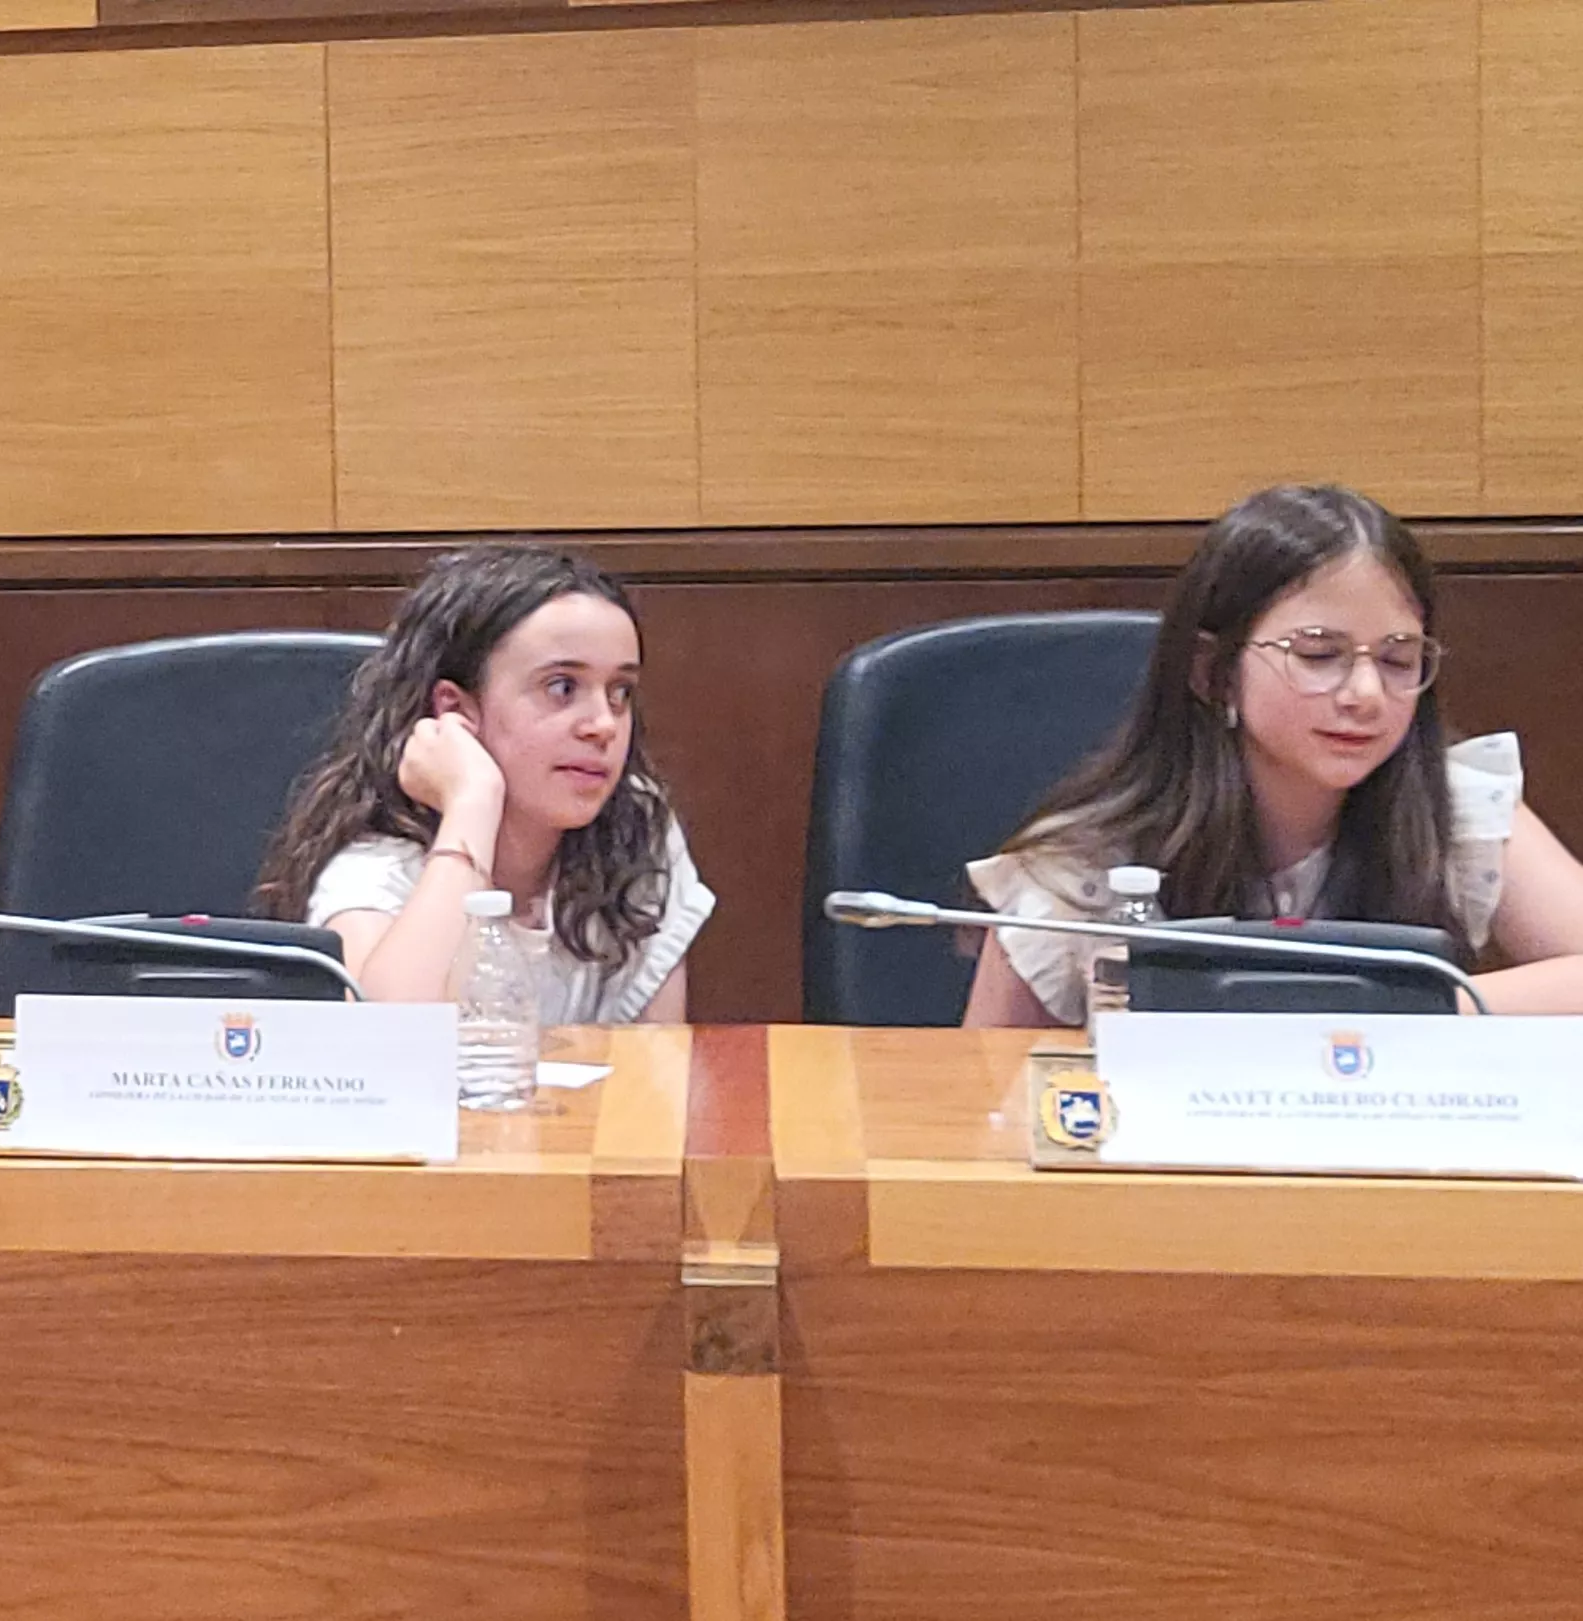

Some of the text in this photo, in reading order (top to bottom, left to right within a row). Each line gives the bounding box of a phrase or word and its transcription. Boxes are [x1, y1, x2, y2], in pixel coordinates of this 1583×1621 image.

[111, 1069, 365, 1092] MARTA CAÑAS FERRANDO
[1391, 1091, 1519, 1108] CUADRADO
